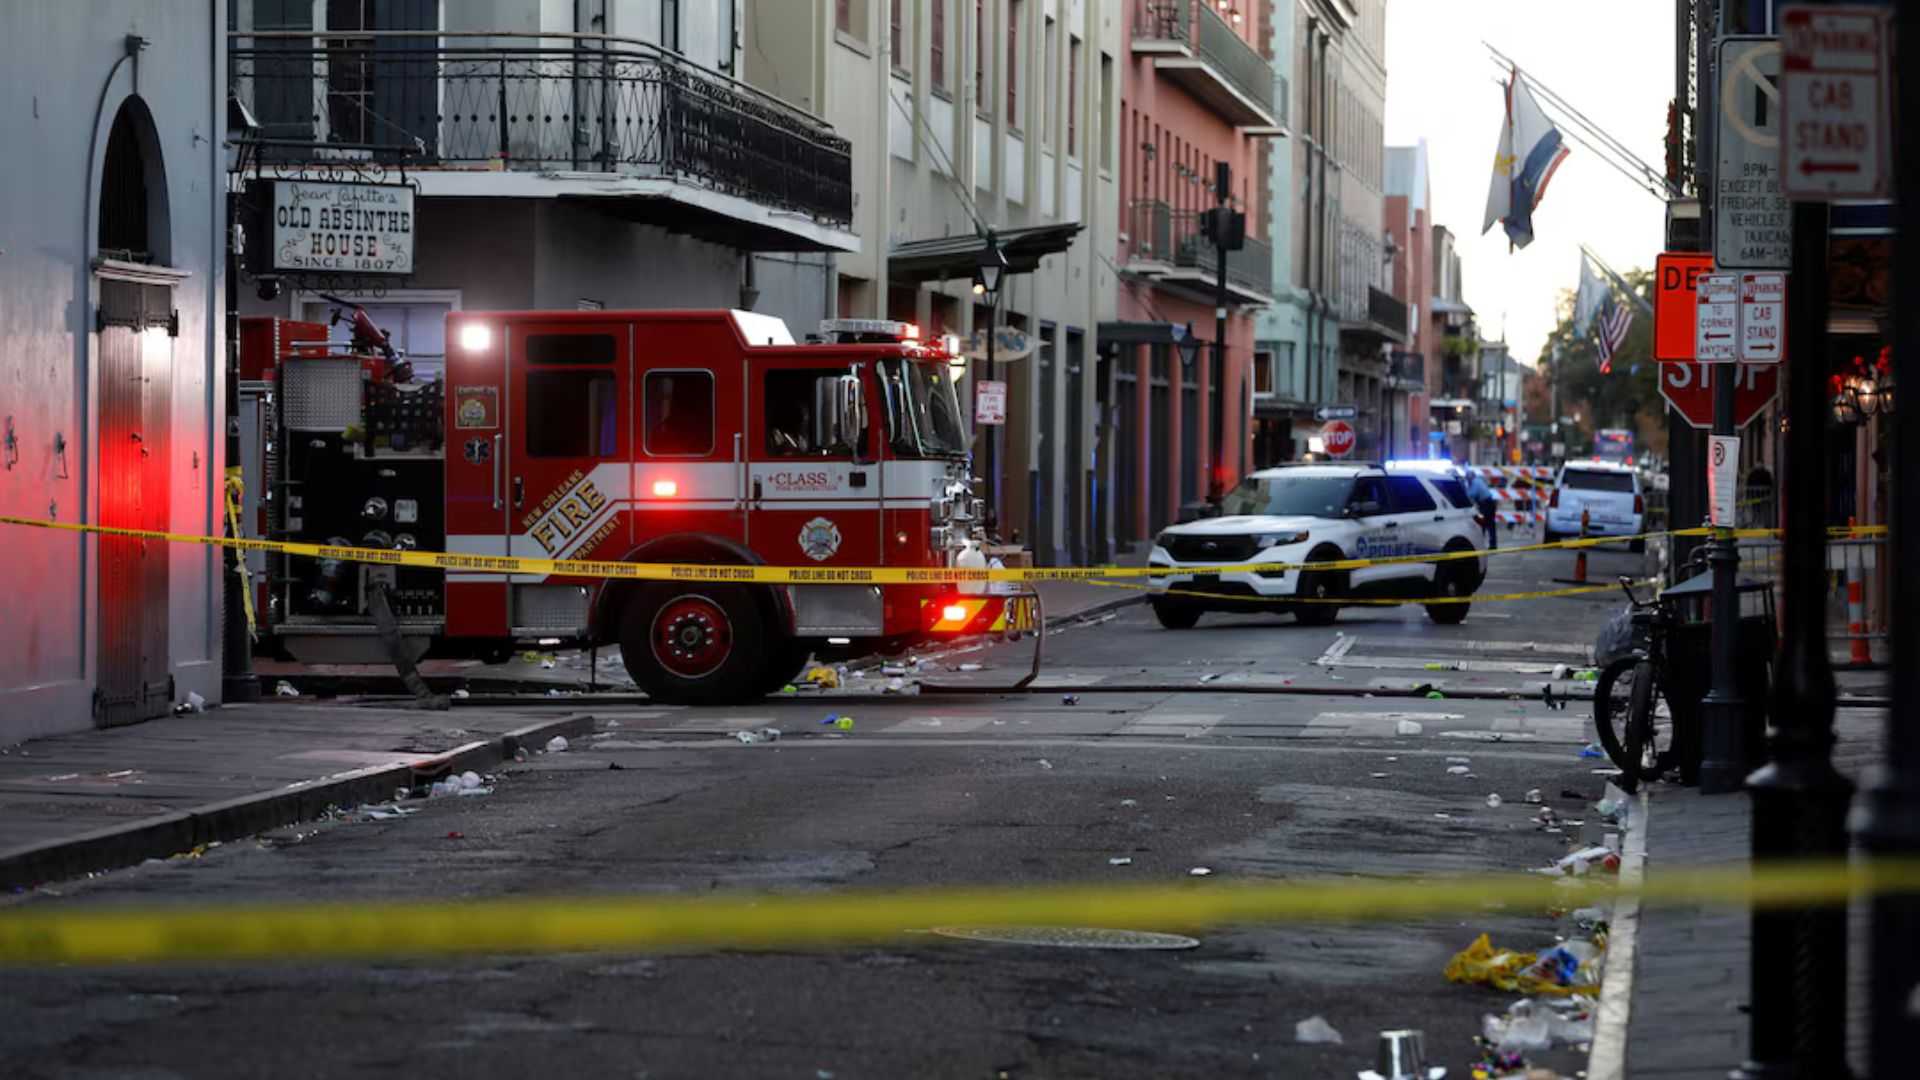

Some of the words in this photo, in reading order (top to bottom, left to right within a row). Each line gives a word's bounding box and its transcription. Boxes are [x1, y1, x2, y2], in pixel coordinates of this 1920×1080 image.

[278, 205, 311, 229] OLD
[319, 207, 410, 234] ABSINTHE
[310, 232, 377, 258] HOUSE
[293, 255, 344, 268] SINCE
[354, 259, 395, 270] 1807
[1752, 306, 1773, 320] CAB
[1746, 325, 1777, 340] STAND
[1667, 361, 1774, 391] STP
[1323, 431, 1354, 446] STOP
[775, 471, 828, 486] CLASS
[543, 469, 585, 508] ORLEANS
[531, 480, 607, 554] FIRE
[435, 556, 457, 567] POLICE
[483, 558, 496, 568] NOT
[553, 562, 576, 573] POLICE
[602, 564, 615, 574] NOT
[719, 567, 732, 578] NOT
[789, 569, 811, 580] POLICE
[837, 570, 849, 580] NOT
[906, 570, 928, 580] POLICE
[954, 570, 966, 580] NOT
